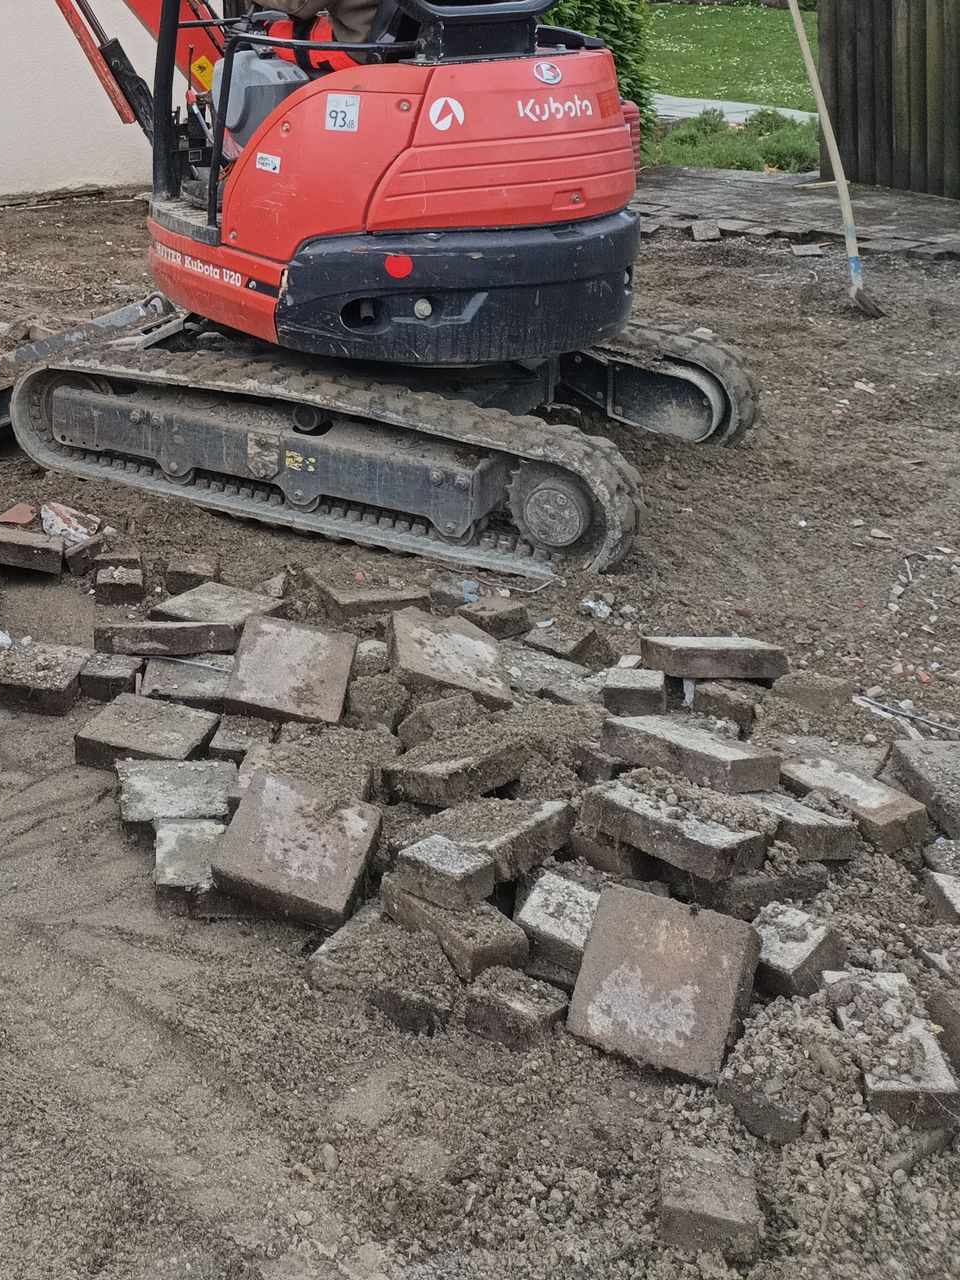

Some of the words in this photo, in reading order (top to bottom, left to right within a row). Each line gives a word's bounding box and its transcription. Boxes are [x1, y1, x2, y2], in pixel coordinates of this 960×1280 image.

[517, 94, 593, 122] Kubota
[184, 255, 220, 280] Kubota
[222, 268, 242, 287] U20
